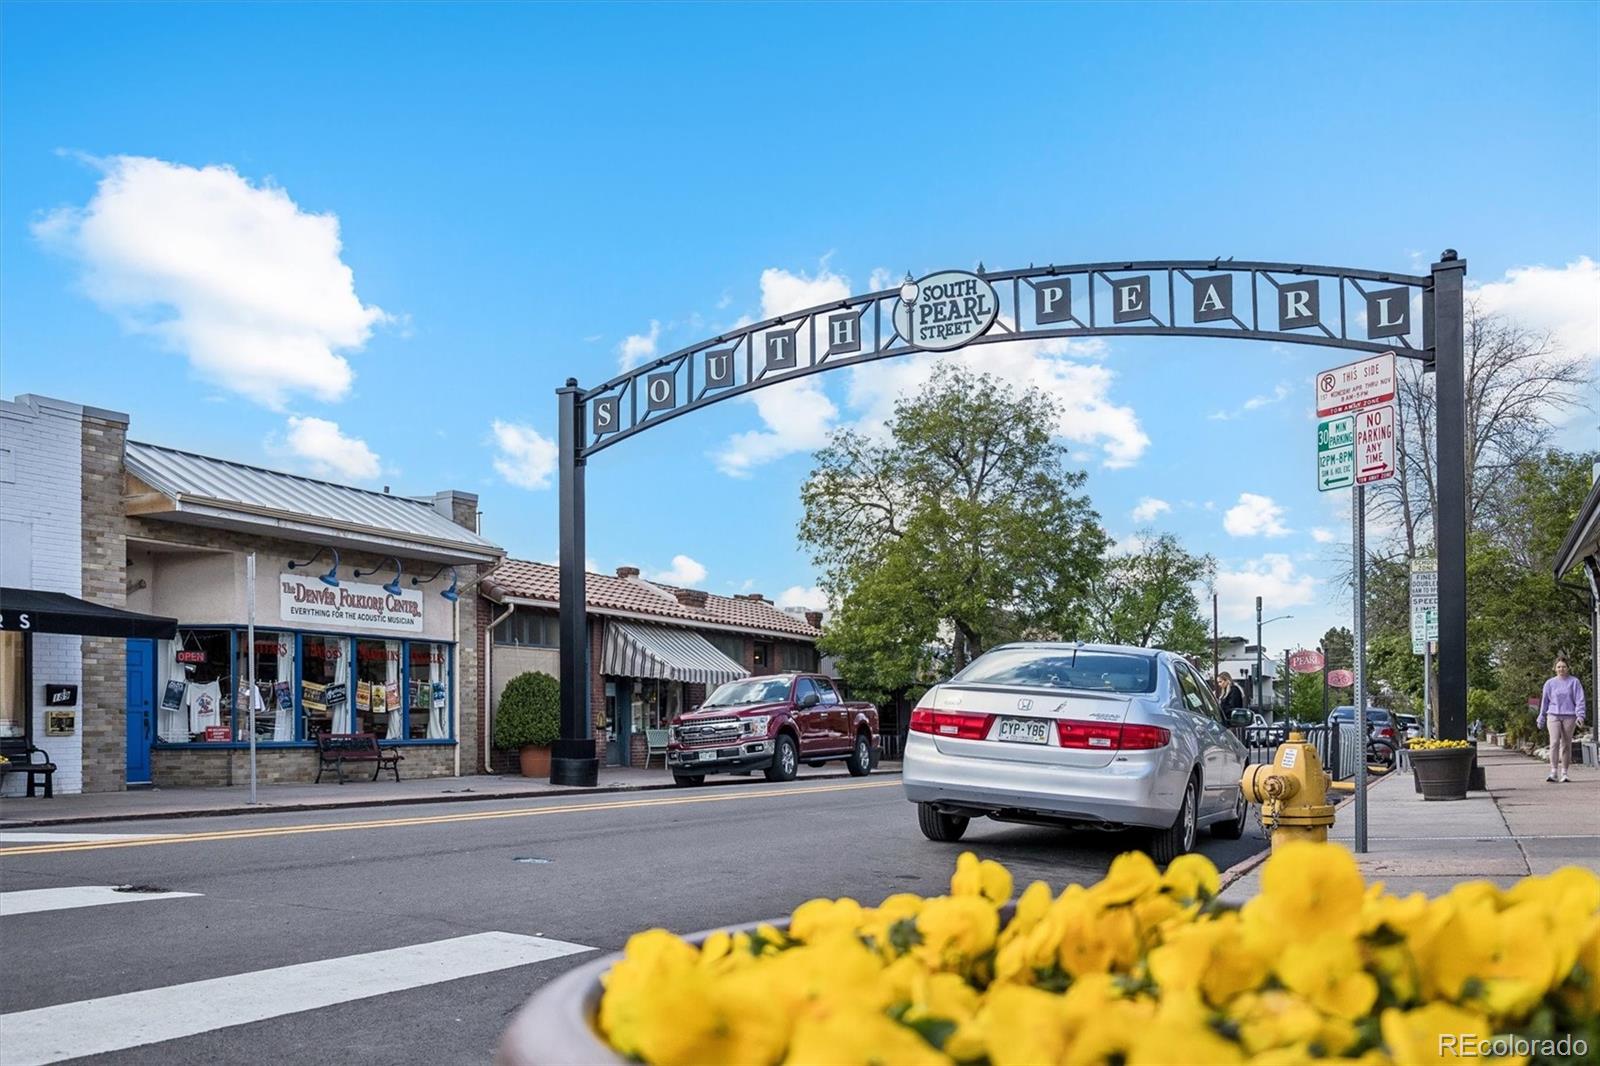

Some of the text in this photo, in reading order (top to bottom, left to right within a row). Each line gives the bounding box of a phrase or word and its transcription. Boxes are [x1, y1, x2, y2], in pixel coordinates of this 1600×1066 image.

[923, 279, 977, 302] SOUTH
[919, 294, 991, 325] PEARL
[920, 320, 972, 340] STREET
[598, 283, 1404, 426] SOUTH PEARL
[1343, 364, 1379, 383] THIS SIDE
[1330, 406, 1343, 414] TOW
[1363, 397, 1380, 406] ZONE
[1335, 422, 1347, 433] MIN
[1367, 412, 1381, 427] NO
[1319, 429, 1328, 445] 30
[1330, 432, 1353, 446] PARKING
[1358, 425, 1391, 445] PARKING
[1366, 441, 1382, 453] ANY
[1365, 452, 1383, 464] TIME
[339, 588, 384, 615] FOLKLORE
[290, 606, 415, 625] EVERYTHING FOR THE ACOUSTIC MUSICIAN
[178, 651, 205, 662] OPEN
[1293, 656, 1318, 667] PEARL
